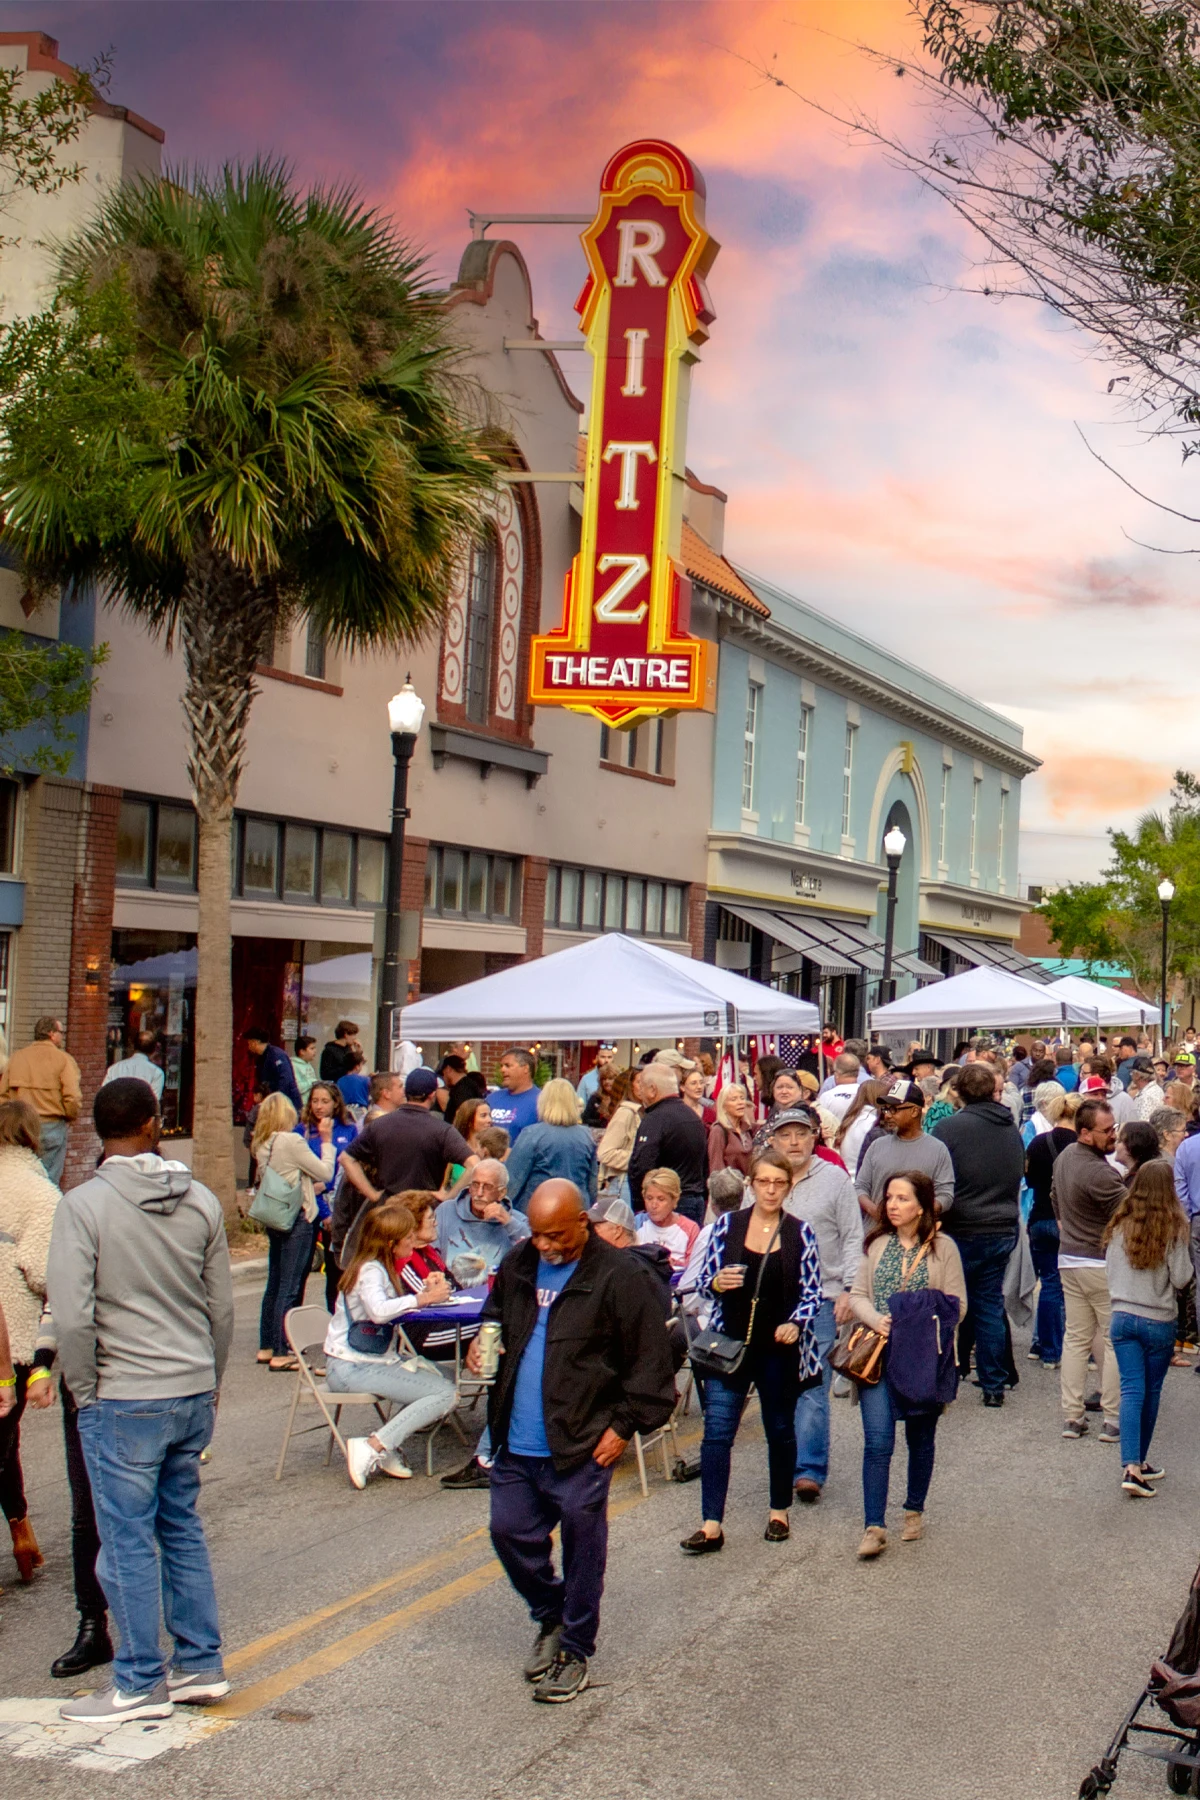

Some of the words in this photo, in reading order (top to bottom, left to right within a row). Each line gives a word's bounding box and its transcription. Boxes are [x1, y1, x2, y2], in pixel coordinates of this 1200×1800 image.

[592, 218, 668, 625] RITZ
[545, 655, 690, 689] THEATRE
[490, 1108, 514, 1120] USA
